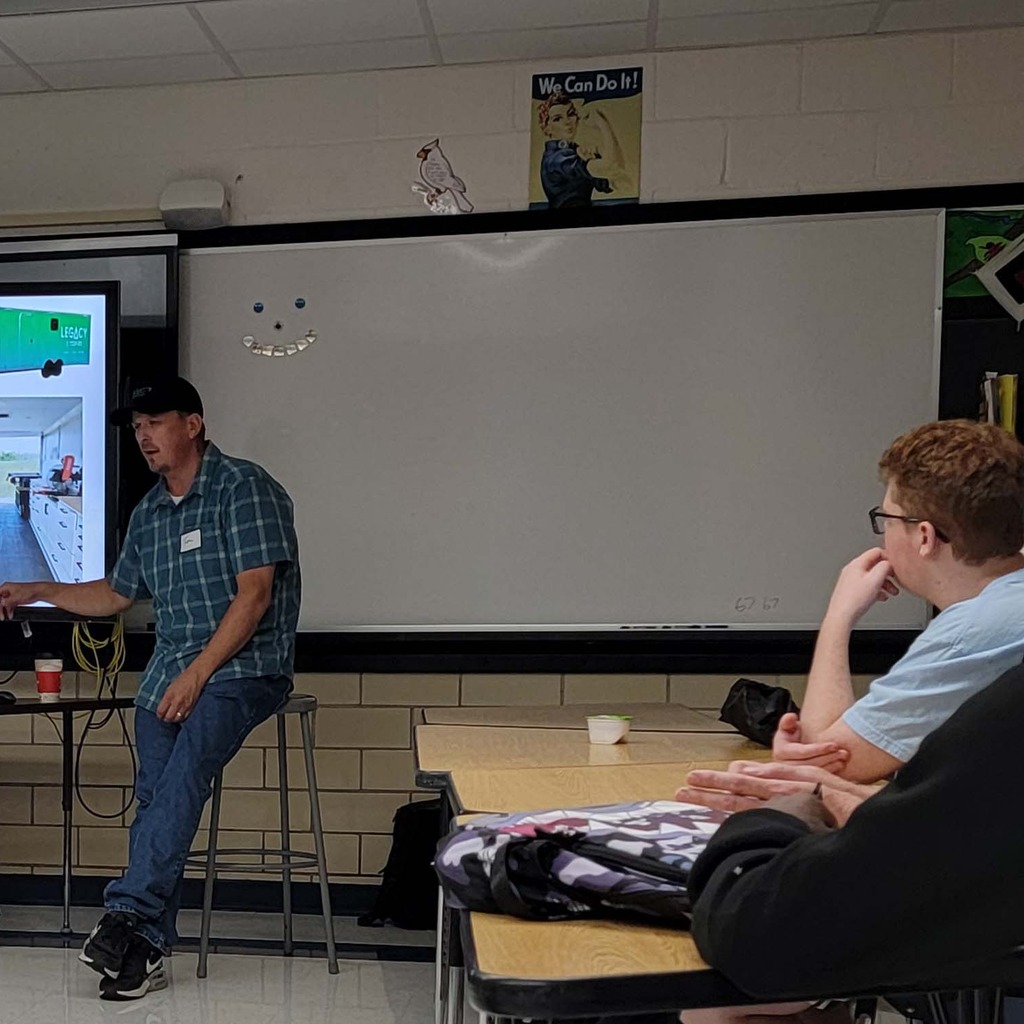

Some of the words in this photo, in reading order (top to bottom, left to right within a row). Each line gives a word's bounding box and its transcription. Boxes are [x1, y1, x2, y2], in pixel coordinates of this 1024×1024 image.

[538, 77, 562, 95] We
[564, 75, 593, 93] Can
[596, 74, 617, 91] Do
[621, 71, 638, 89] It!
[60, 326, 88, 340] LEGACY
